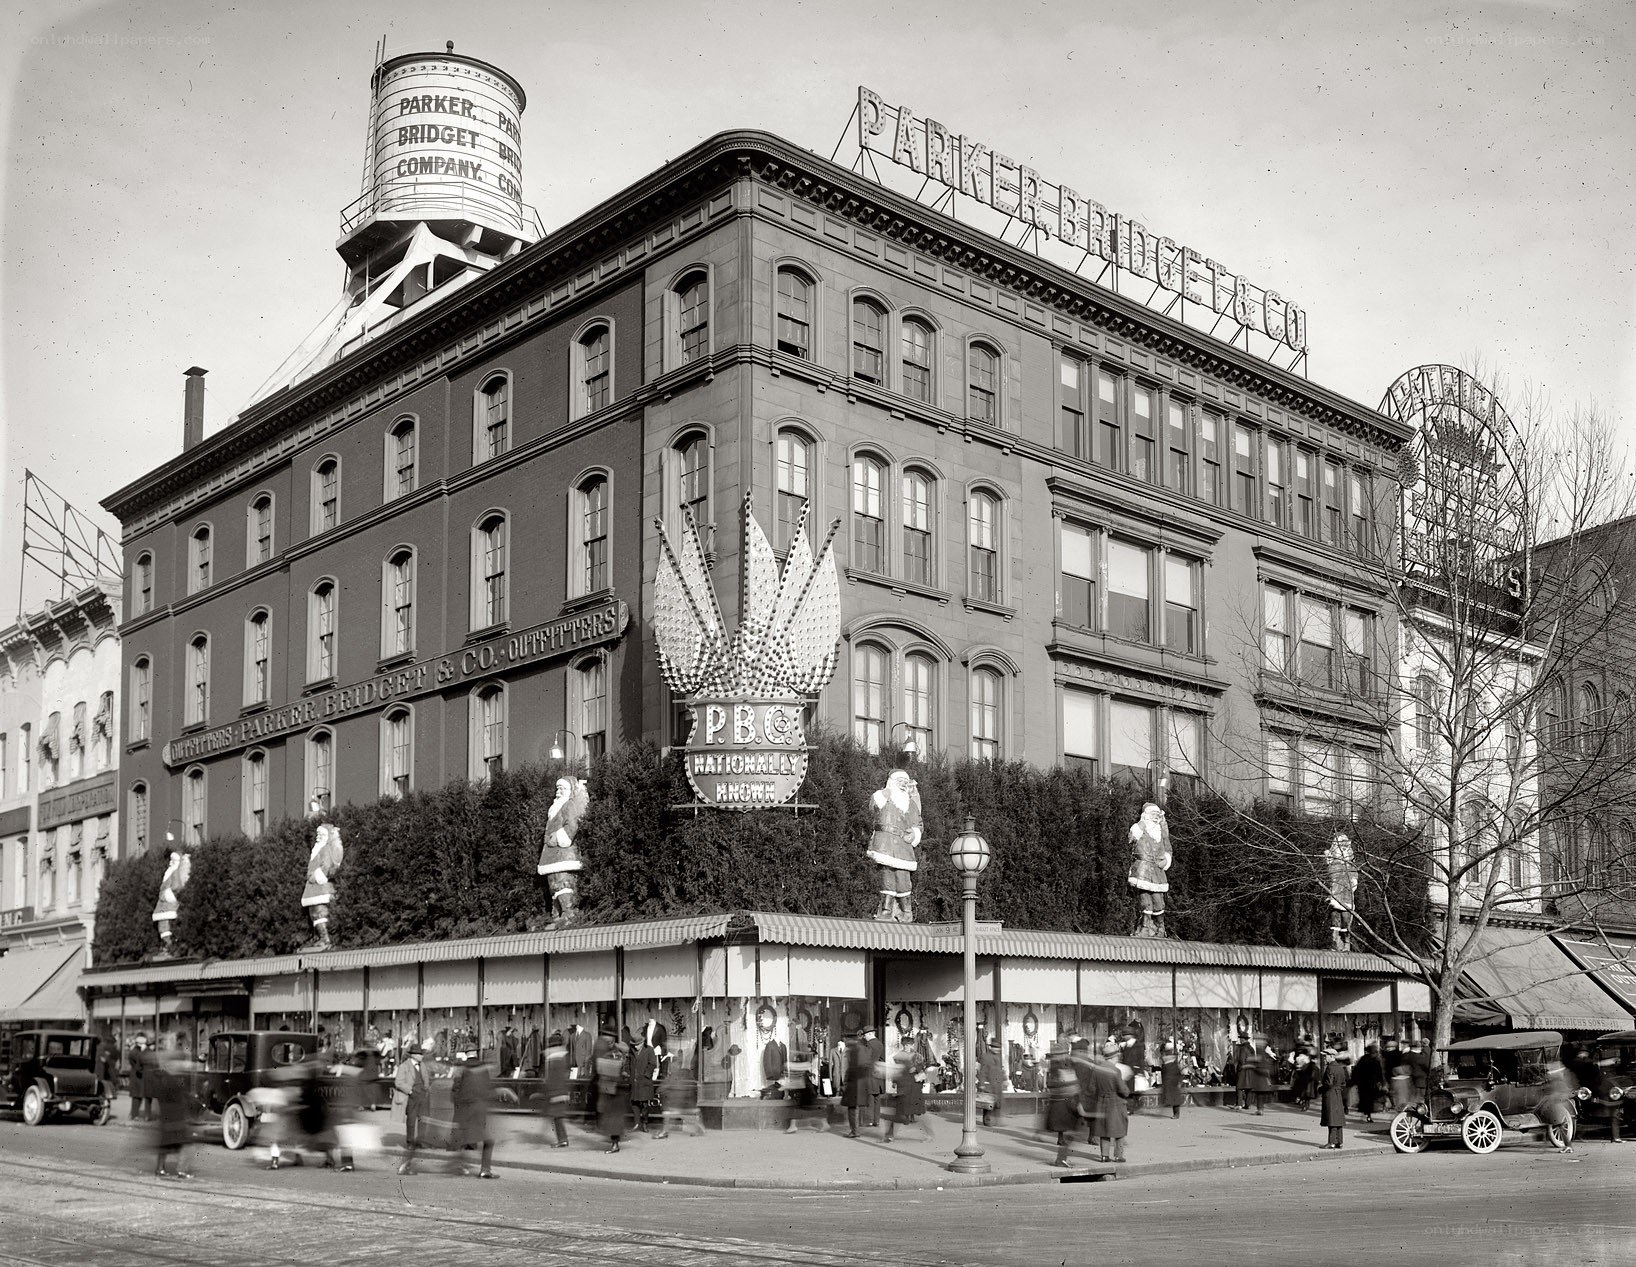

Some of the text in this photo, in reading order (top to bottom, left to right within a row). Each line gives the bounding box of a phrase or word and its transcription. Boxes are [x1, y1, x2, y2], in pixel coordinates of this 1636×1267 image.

[400, 94, 477, 121] PARKER,
[398, 124, 480, 149] BRIDGET
[396, 156, 483, 181] COMPANY.
[858, 85, 1053, 241] PARKER,
[1057, 183, 1226, 314] BRIDGET
[1233, 274, 1256, 331] &
[171, 606, 616, 761] OUTFITTERS PARKER, BRIDGET & CO. OUTFITTERS
[694, 753, 800, 775] NATIONALLY
[716, 781, 776, 803] KNOWN
